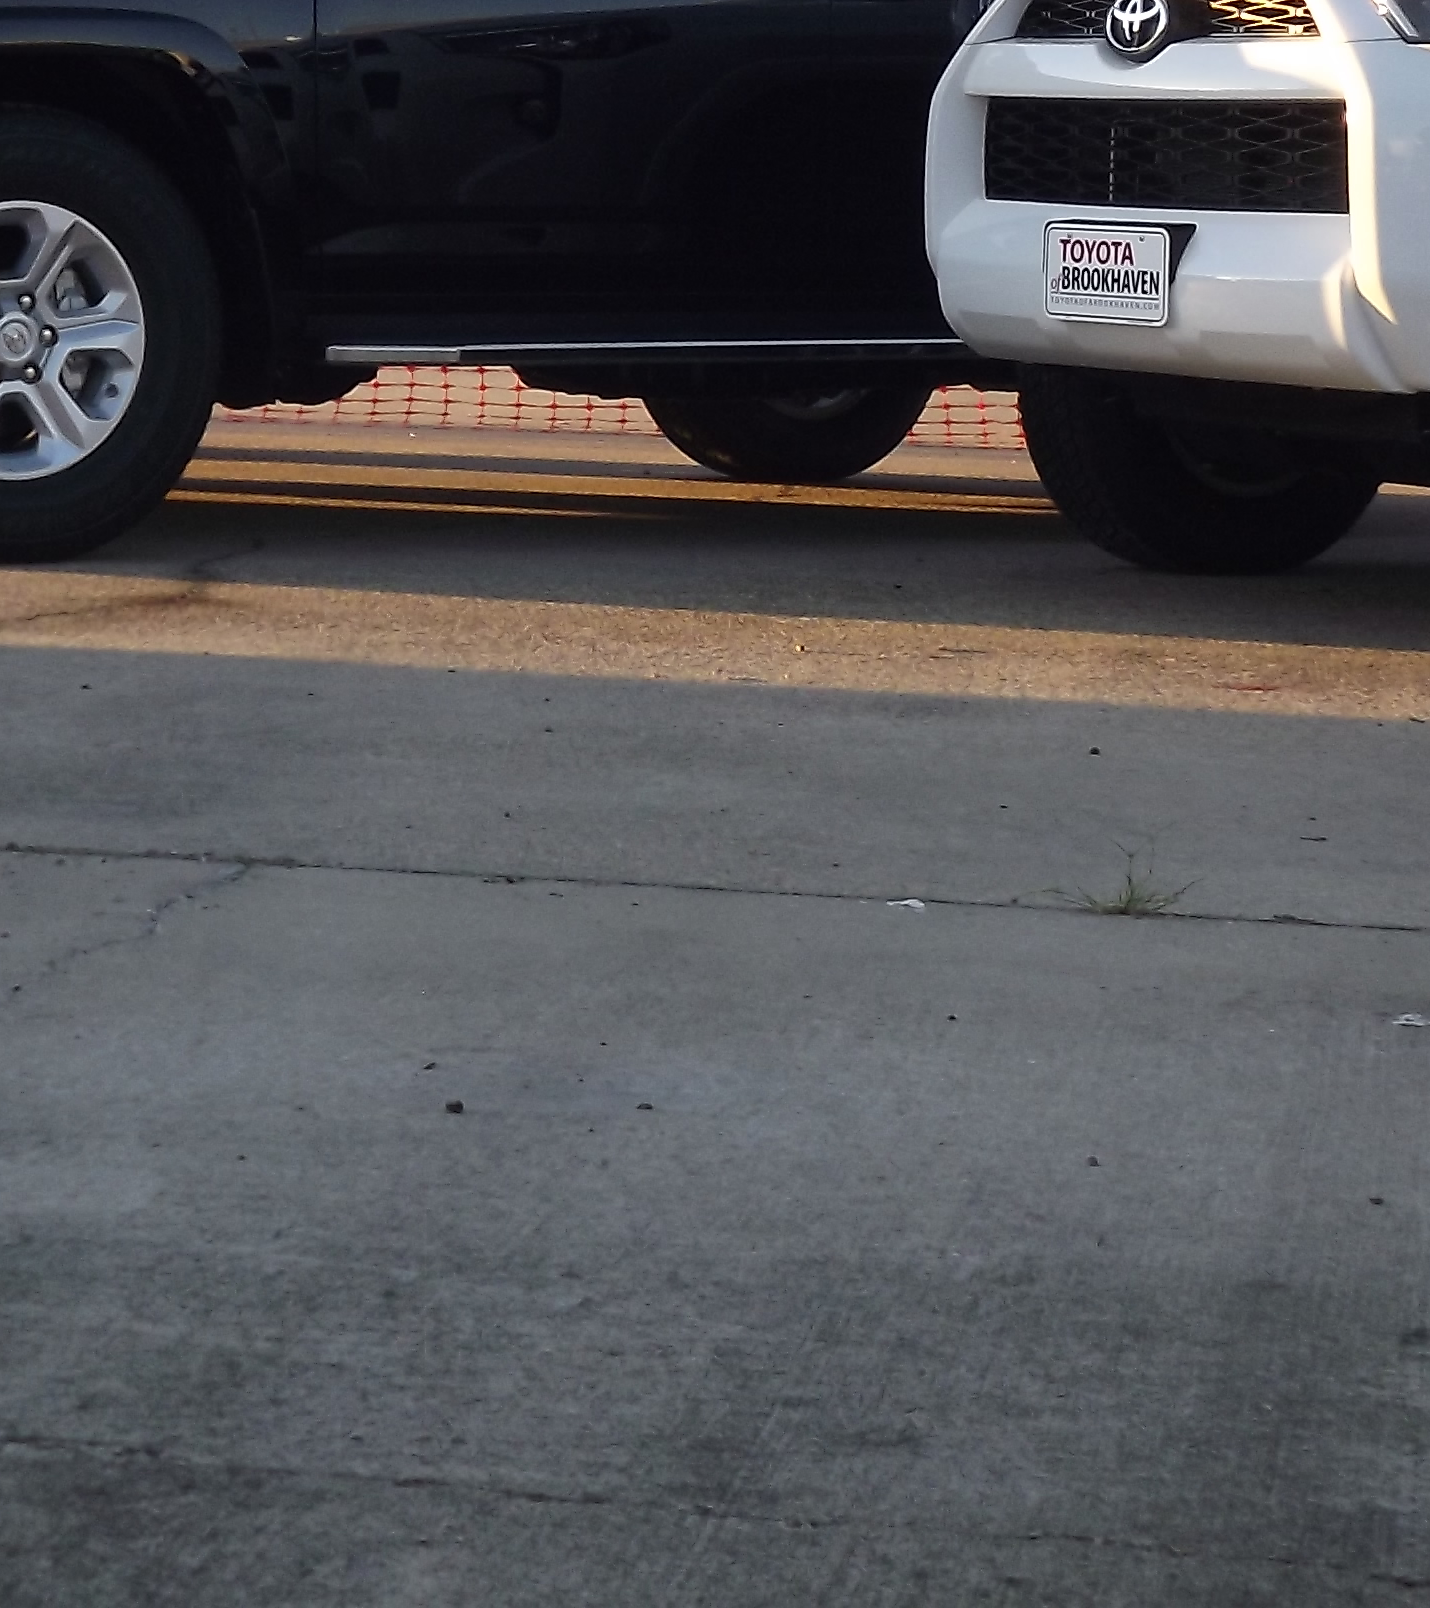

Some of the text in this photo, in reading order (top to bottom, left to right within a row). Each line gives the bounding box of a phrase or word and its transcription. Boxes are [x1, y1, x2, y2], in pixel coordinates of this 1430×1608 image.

[1060, 238, 1135, 266] TOYOTA
[1051, 266, 1160, 296] of BROOKHAVEN
